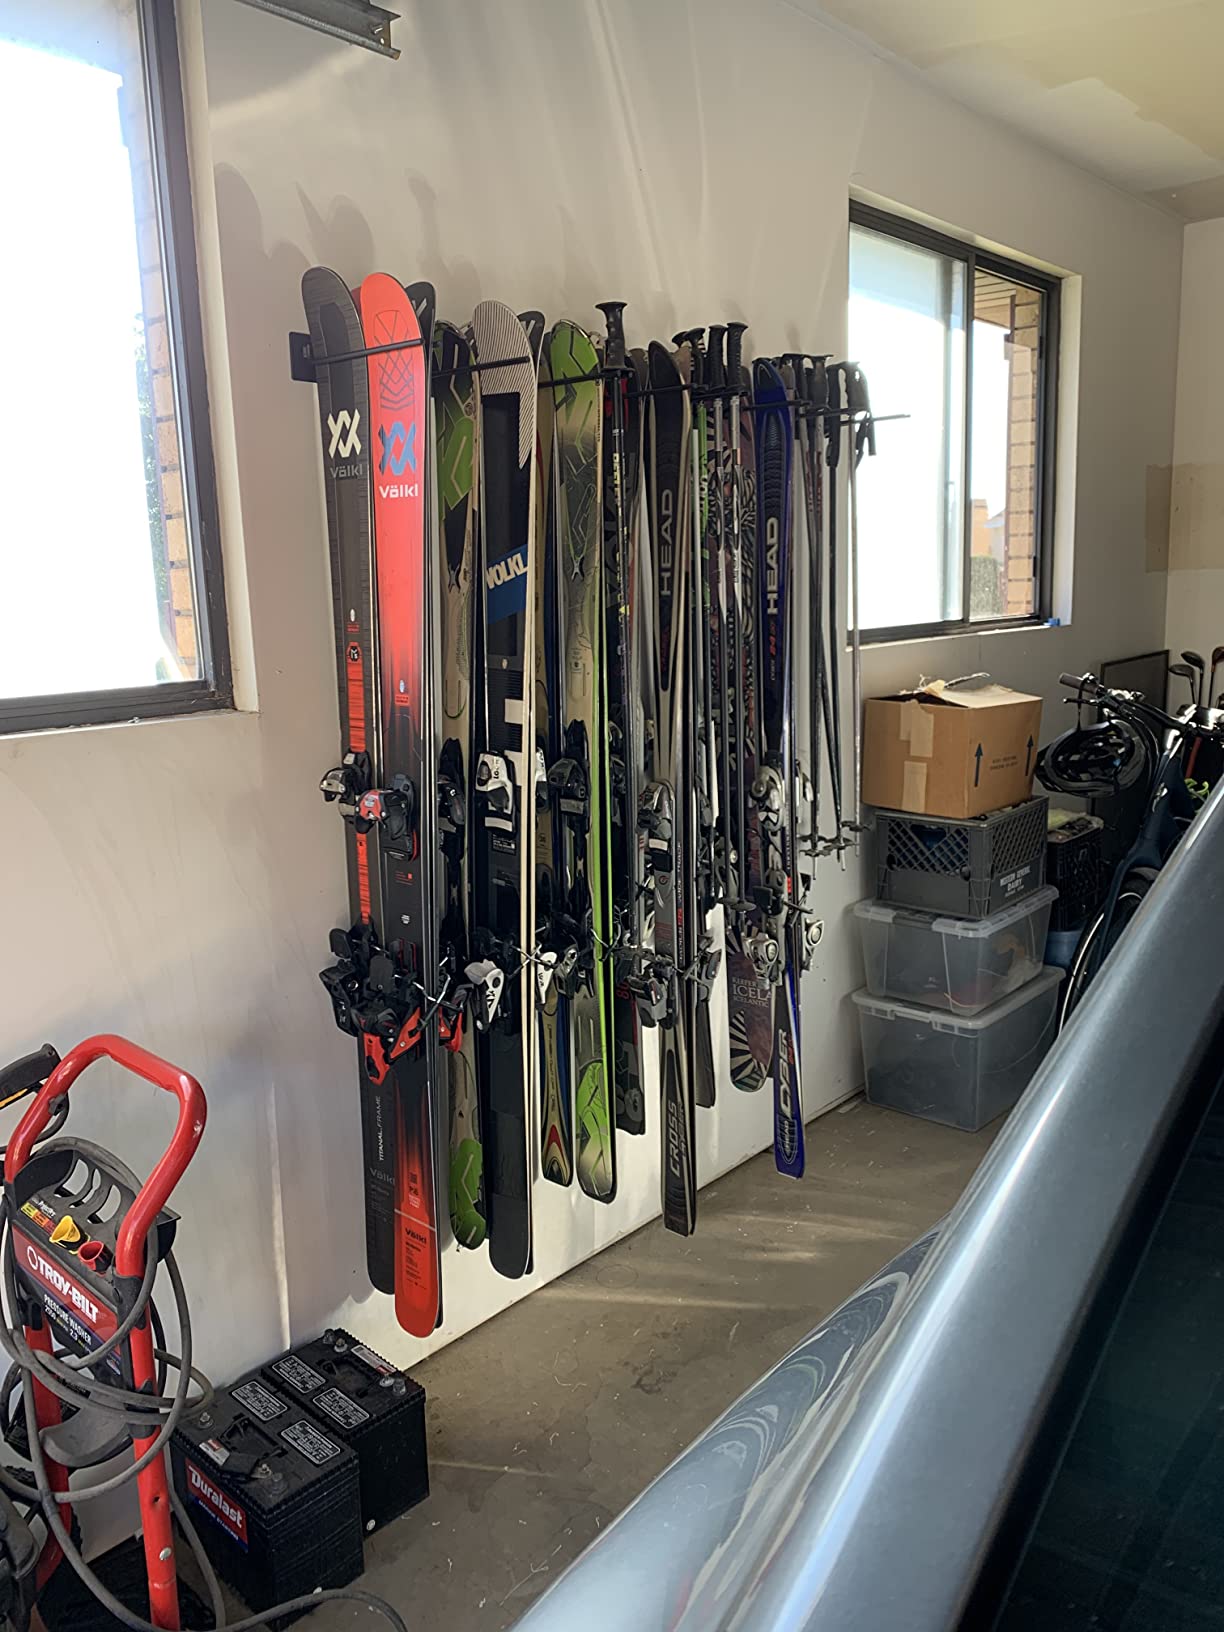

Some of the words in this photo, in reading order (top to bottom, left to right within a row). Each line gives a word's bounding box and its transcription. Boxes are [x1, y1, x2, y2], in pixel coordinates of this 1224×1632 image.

[330, 463, 363, 479] Völkl
[379, 483, 419, 499] Völkl
[660, 488, 673, 597] HEAD
[766, 516, 779, 615] HEAD
[778, 1028, 792, 1120] CYBER
[668, 1099, 680, 1178] CROSS
[37, 1255, 99, 1323] TROY-BILT
[188, 1465, 243, 1529] Duralast
